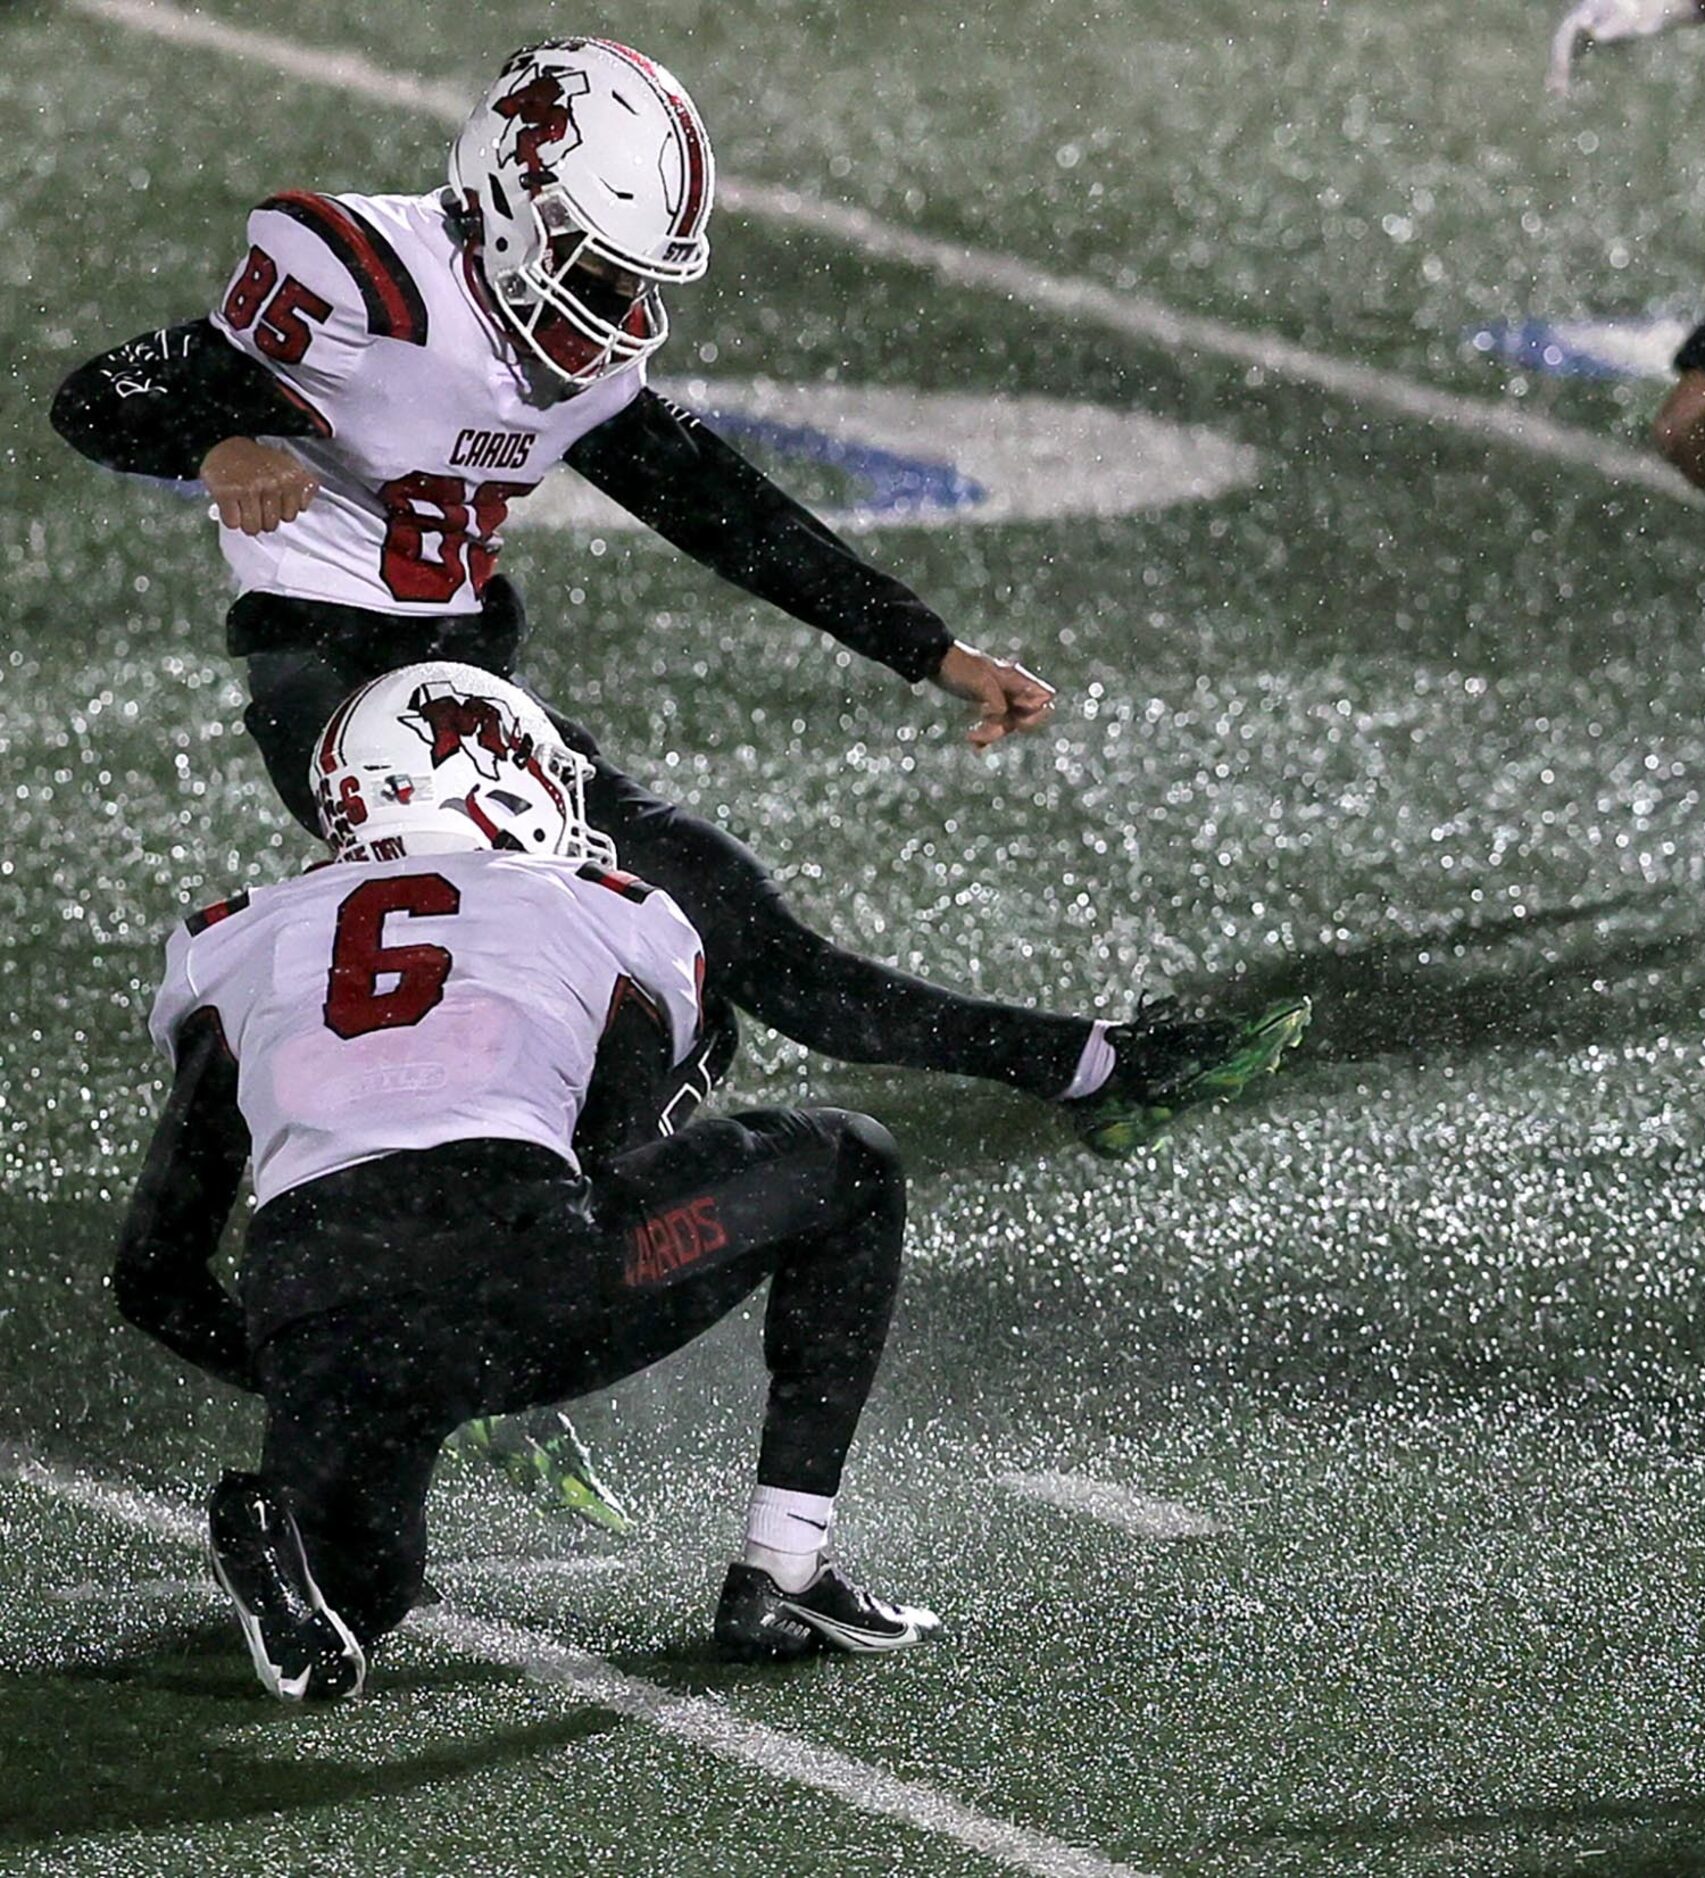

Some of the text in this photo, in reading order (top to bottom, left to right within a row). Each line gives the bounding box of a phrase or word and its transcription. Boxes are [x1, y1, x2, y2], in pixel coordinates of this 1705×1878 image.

[223, 244, 335, 365] 85
[449, 429, 536, 469] CARDS
[322, 873, 461, 1041] 6
